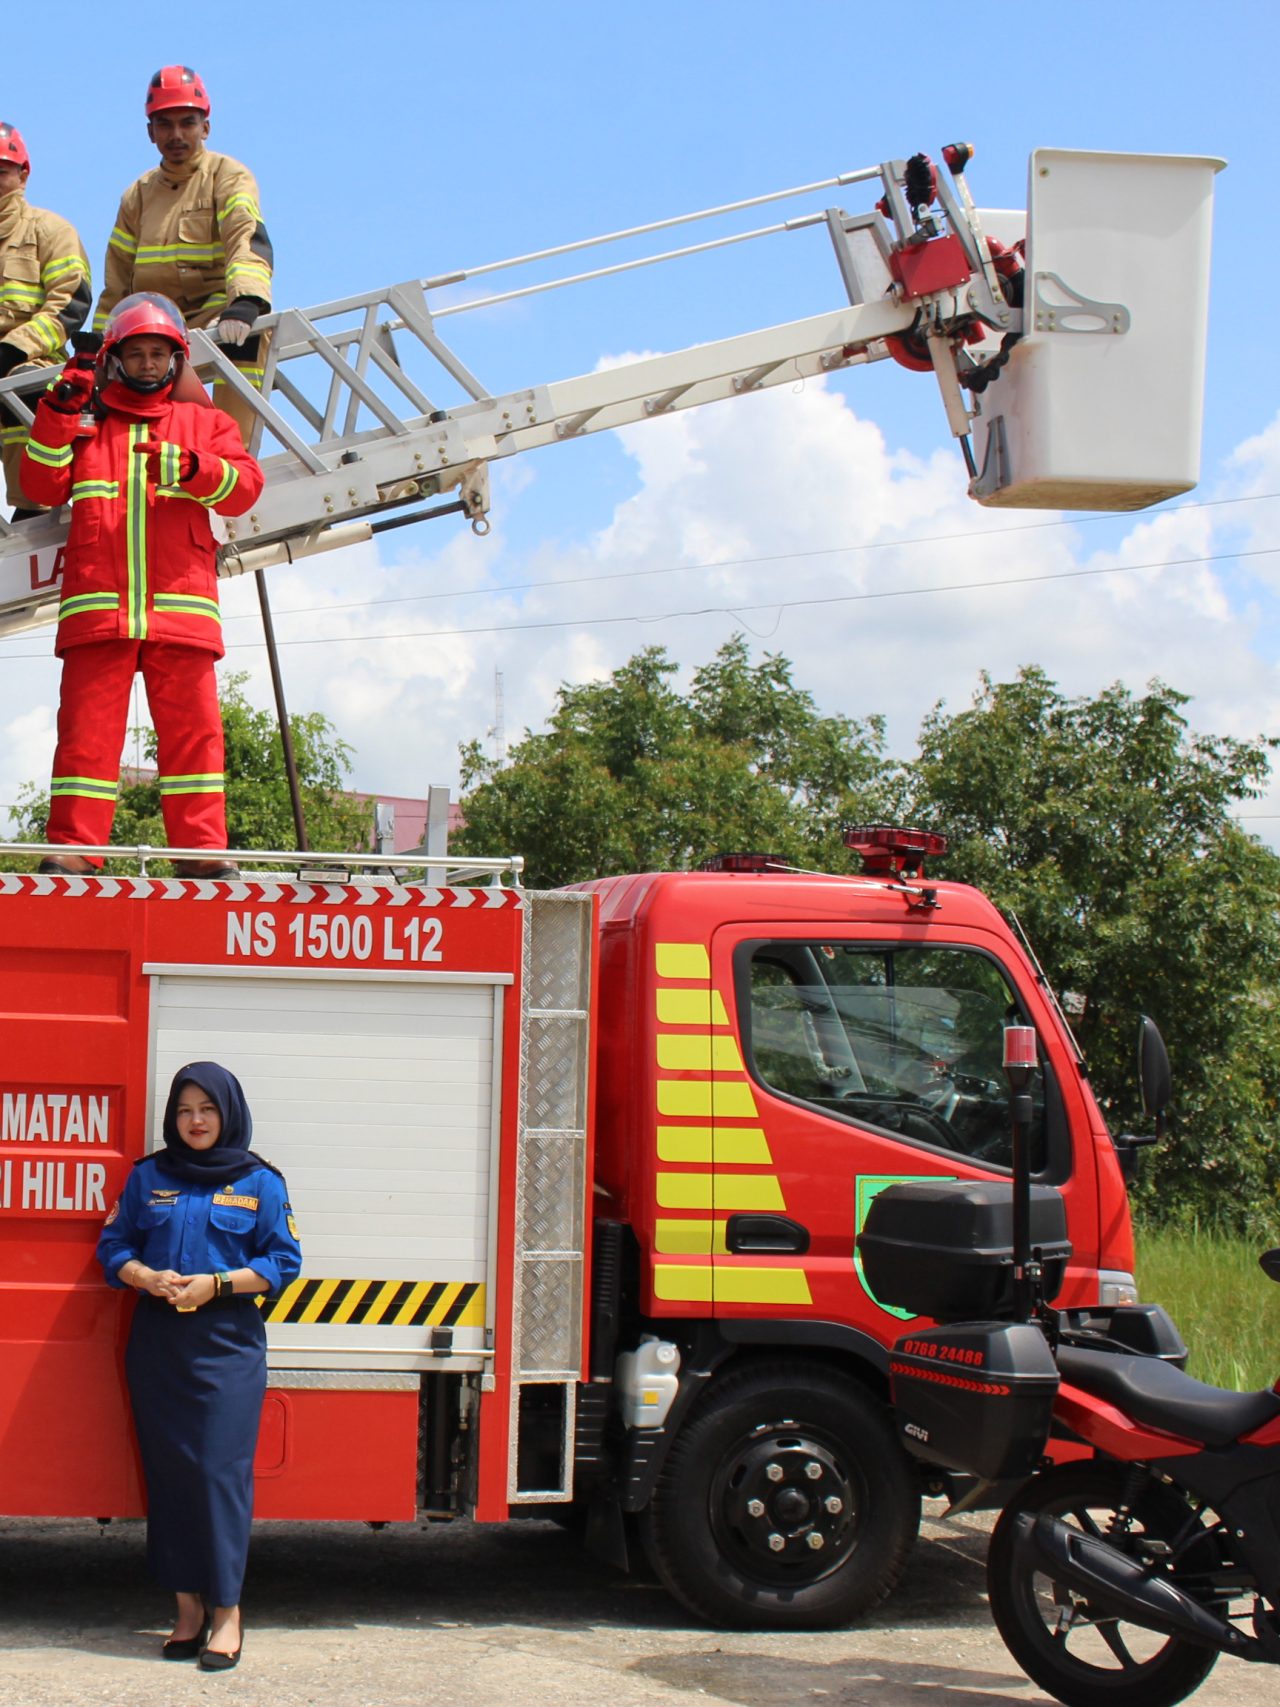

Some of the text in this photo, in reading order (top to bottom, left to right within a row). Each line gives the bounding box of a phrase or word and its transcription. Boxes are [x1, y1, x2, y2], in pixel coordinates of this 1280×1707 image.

[226, 911, 443, 961] NS 1500 L12
[22, 1161, 107, 1212] HILIR
[214, 1195, 258, 1210] PEMADAM
[903, 1339, 938, 1358] 0768
